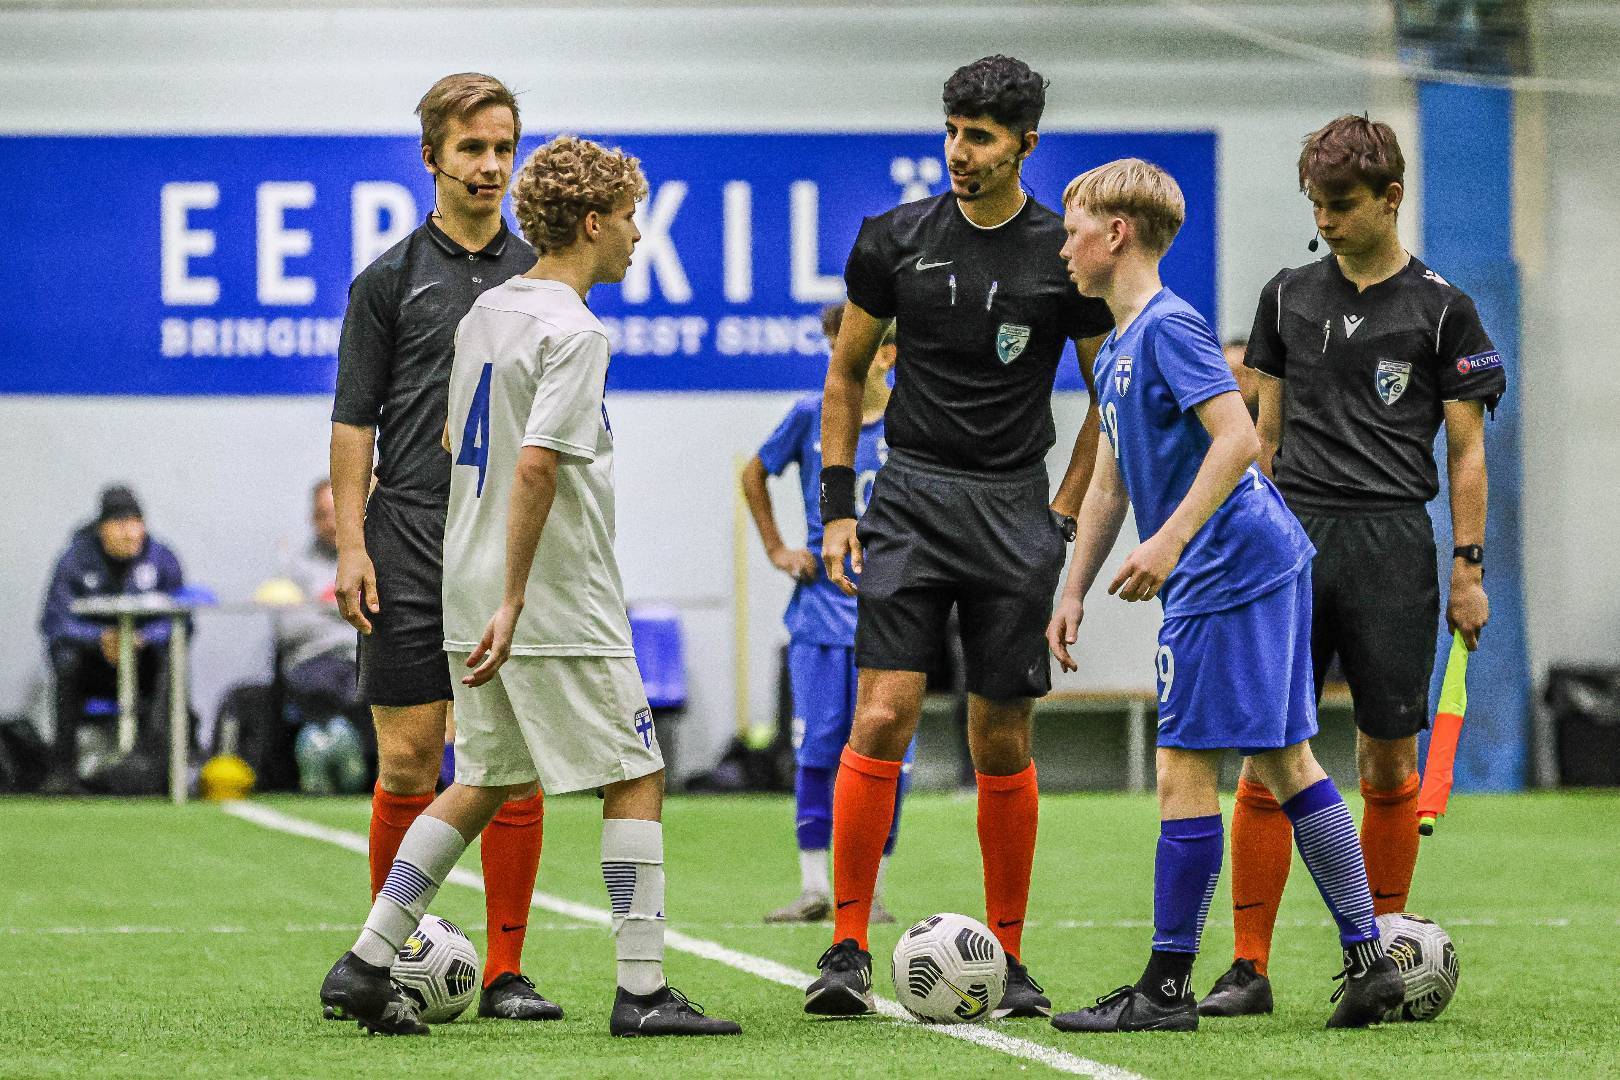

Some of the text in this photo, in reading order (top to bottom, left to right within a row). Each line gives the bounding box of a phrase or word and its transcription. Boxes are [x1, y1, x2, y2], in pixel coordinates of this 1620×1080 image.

[161, 317, 341, 357] BRINGIN
[716, 315, 830, 356] SINC
[455, 362, 493, 499] 4
[1157, 644, 1175, 703] 9
